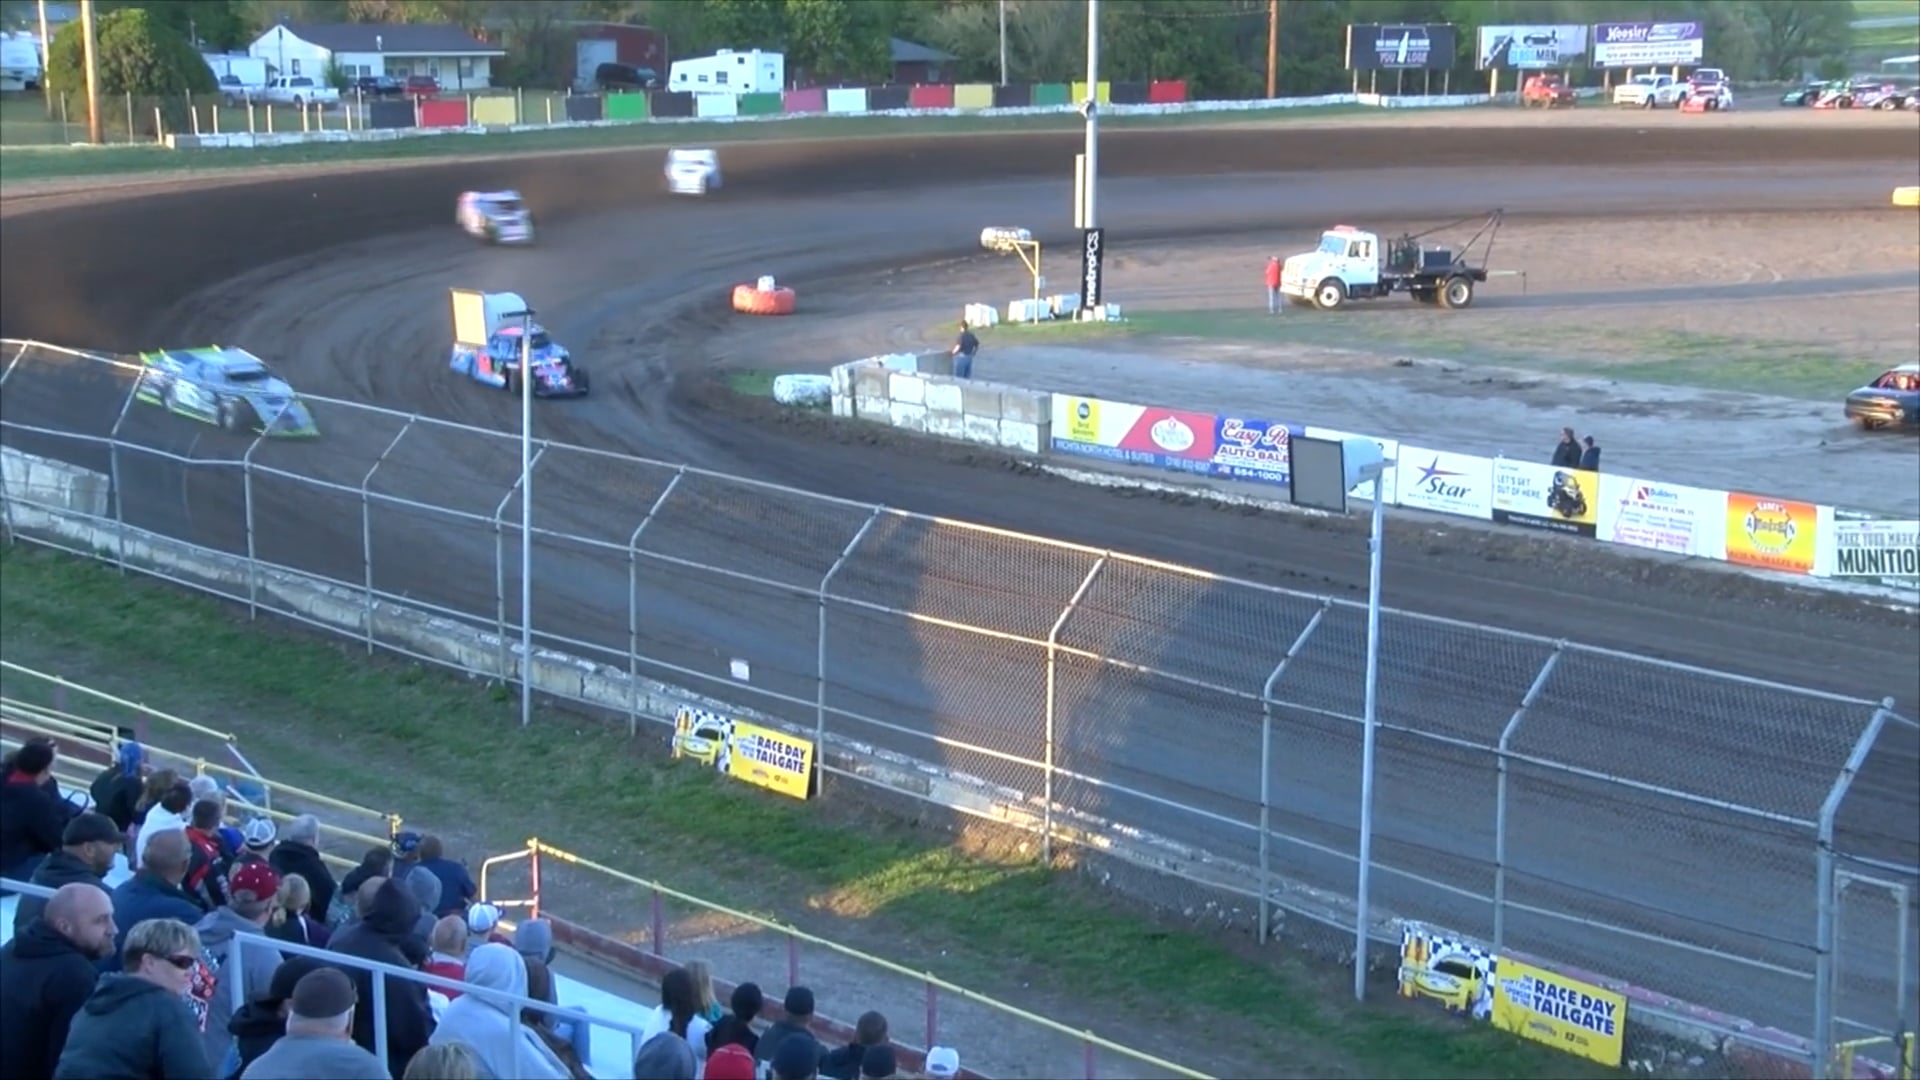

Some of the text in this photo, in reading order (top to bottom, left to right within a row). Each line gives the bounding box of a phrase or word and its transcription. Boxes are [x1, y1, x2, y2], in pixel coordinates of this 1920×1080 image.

[1606, 25, 1648, 41] Hoosier
[1086, 231, 1099, 306] metroPCS
[1222, 420, 1260, 447] Easy
[1220, 446, 1289, 462] AUTO SALE
[1425, 476, 1472, 499] Star
[1497, 484, 1510, 495] OUT
[1838, 549, 1920, 573] MUNITIO
[757, 735, 784, 756] RACE
[785, 744, 806, 760] DAY
[756, 748, 805, 775] TAILGATE
[1535, 979, 1577, 1006] RACE
[1580, 997, 1617, 1018] DAY
[1533, 996, 1616, 1037] TAILGATE
